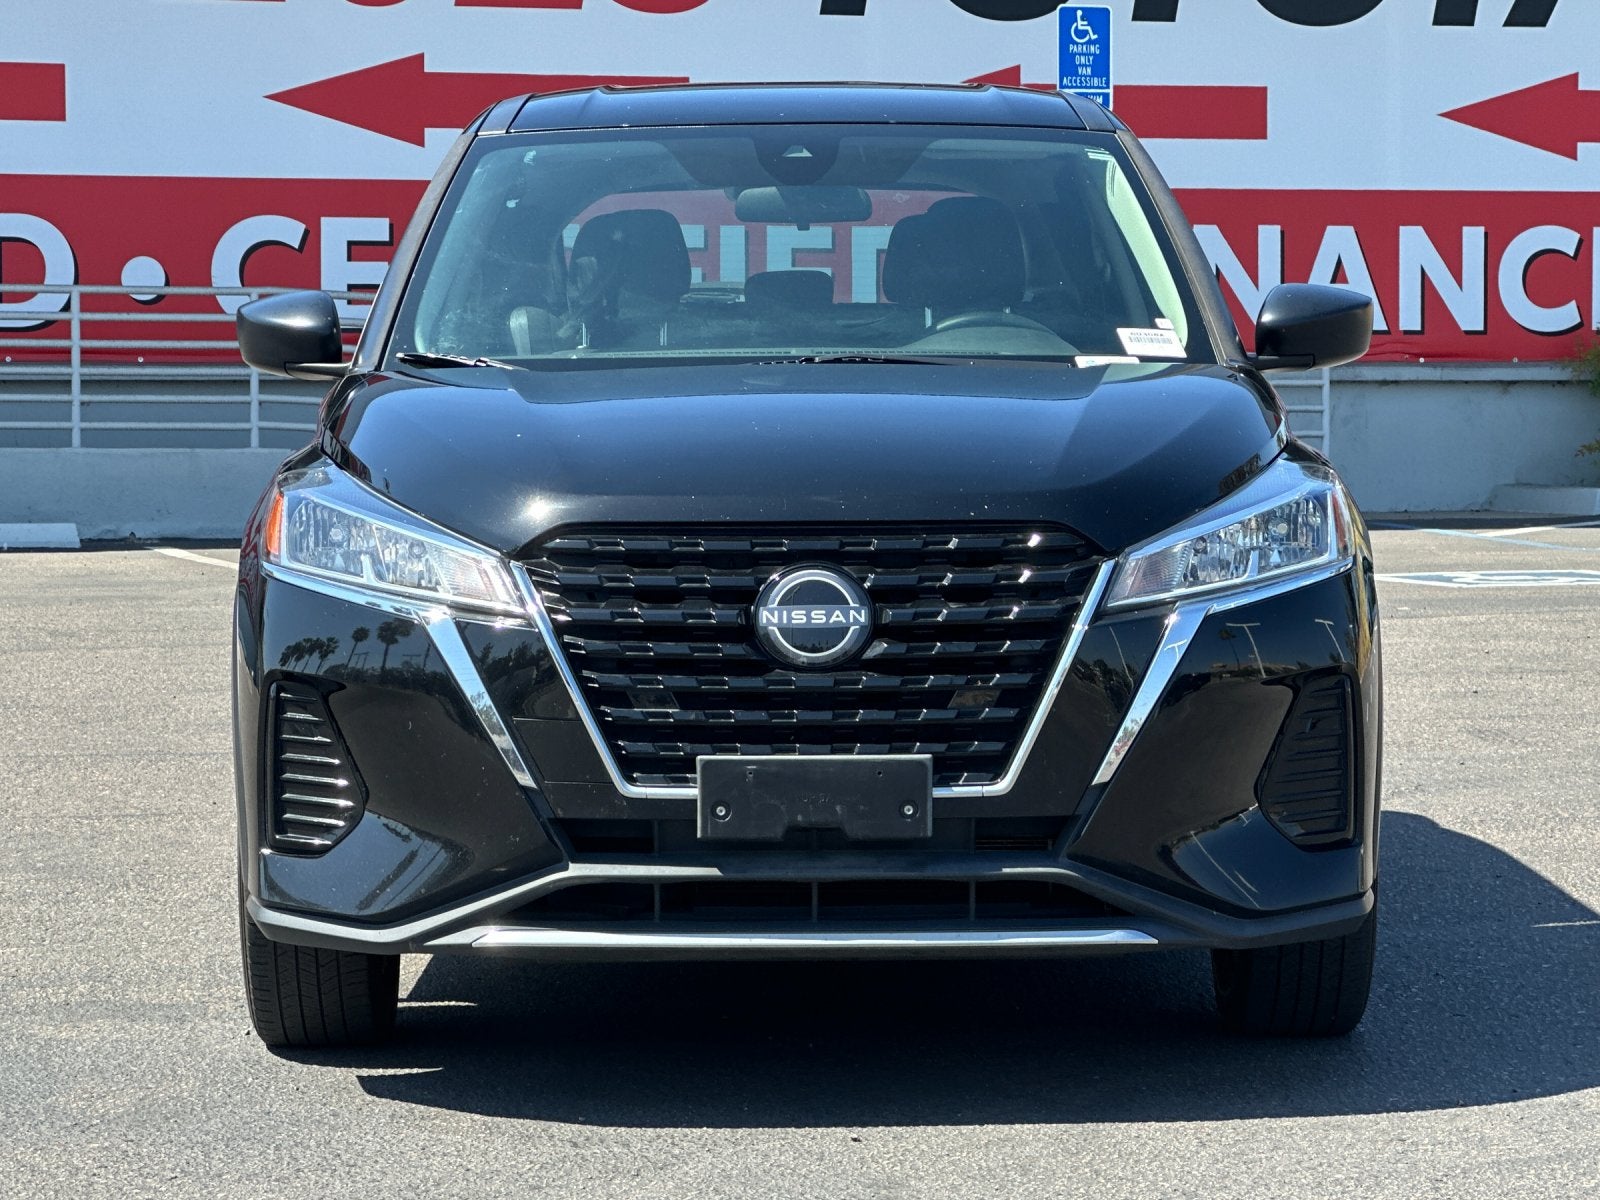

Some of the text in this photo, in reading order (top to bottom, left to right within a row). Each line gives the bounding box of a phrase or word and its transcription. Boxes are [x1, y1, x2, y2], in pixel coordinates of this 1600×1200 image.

[1069, 43, 1100, 54] PARKING
[1075, 55, 1094, 65] ONLY
[1077, 66, 1092, 76] VAN
[1062, 76, 1107, 87] ACCESSIBLE
[762, 609, 866, 624] NISSAN
